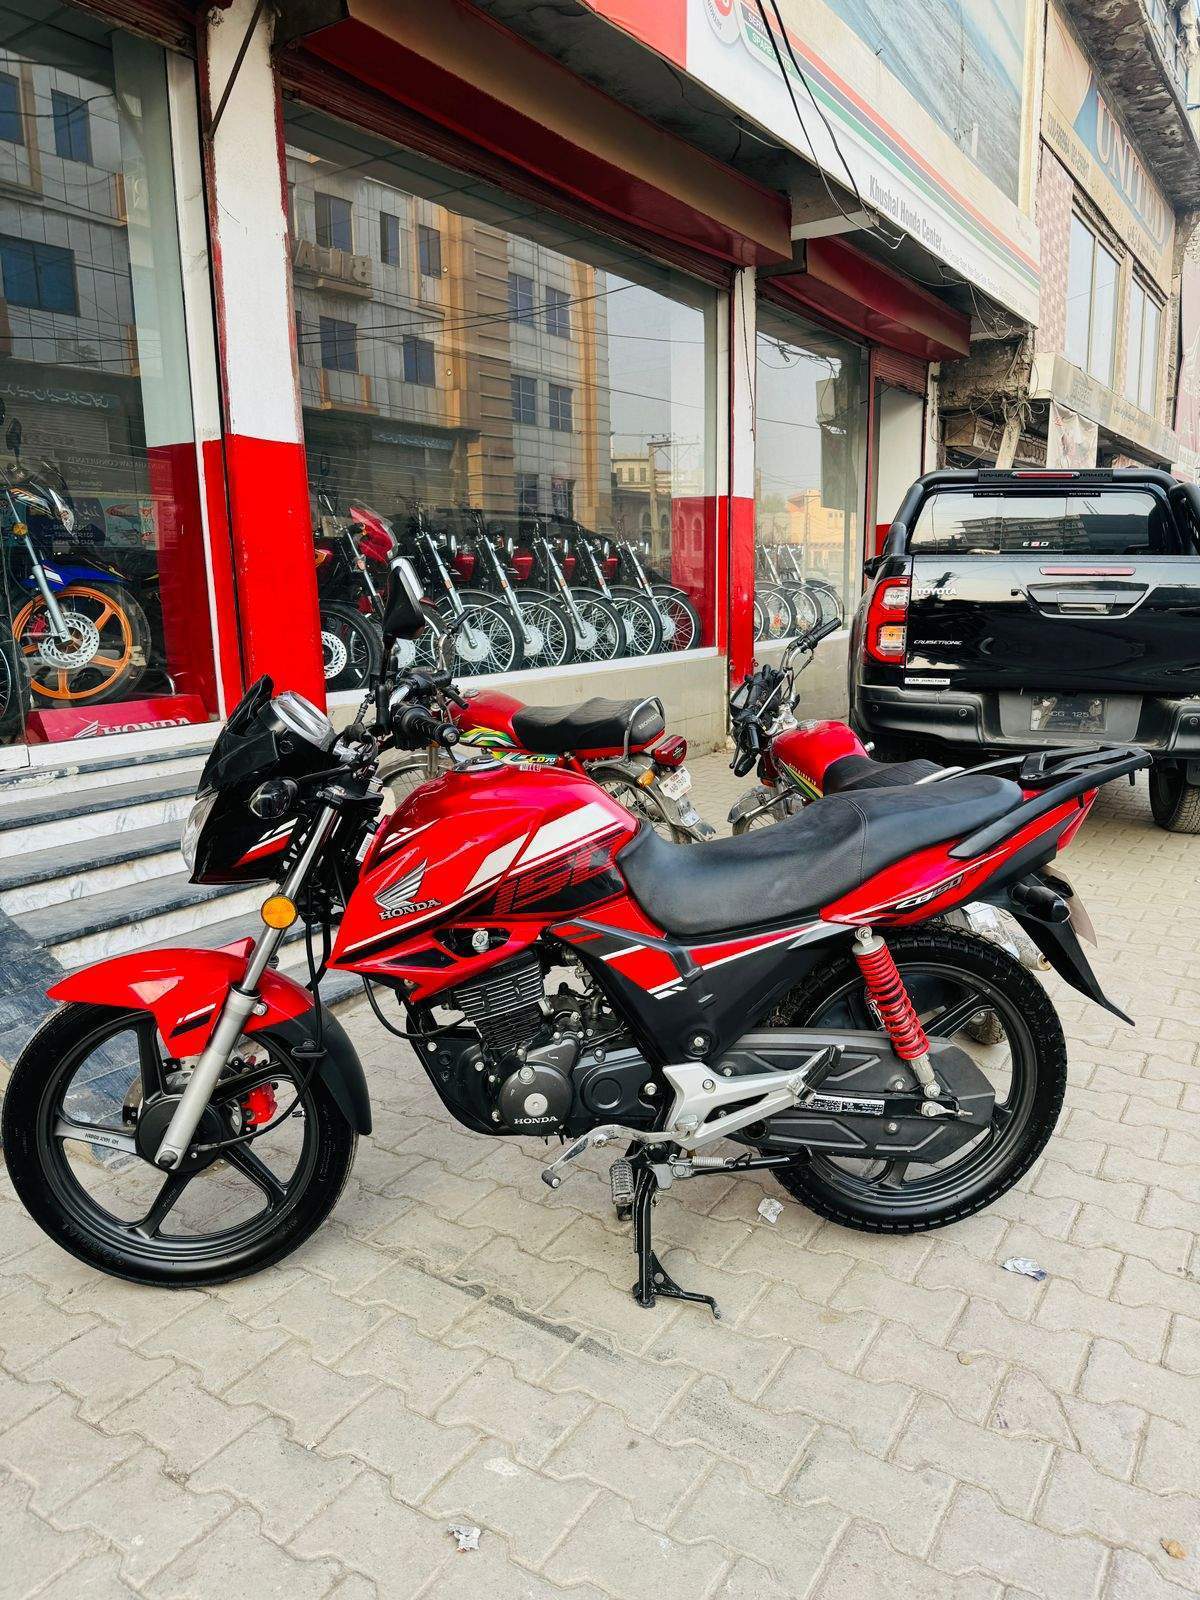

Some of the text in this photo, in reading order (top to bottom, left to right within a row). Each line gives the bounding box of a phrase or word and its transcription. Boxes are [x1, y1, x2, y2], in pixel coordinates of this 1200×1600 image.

[869, 175, 942, 251] Khushal Honda Center
[917, 587, 957, 595] TOYOTA
[379, 899, 442, 921] HONDA
[514, 1115, 559, 1125] HONDA
